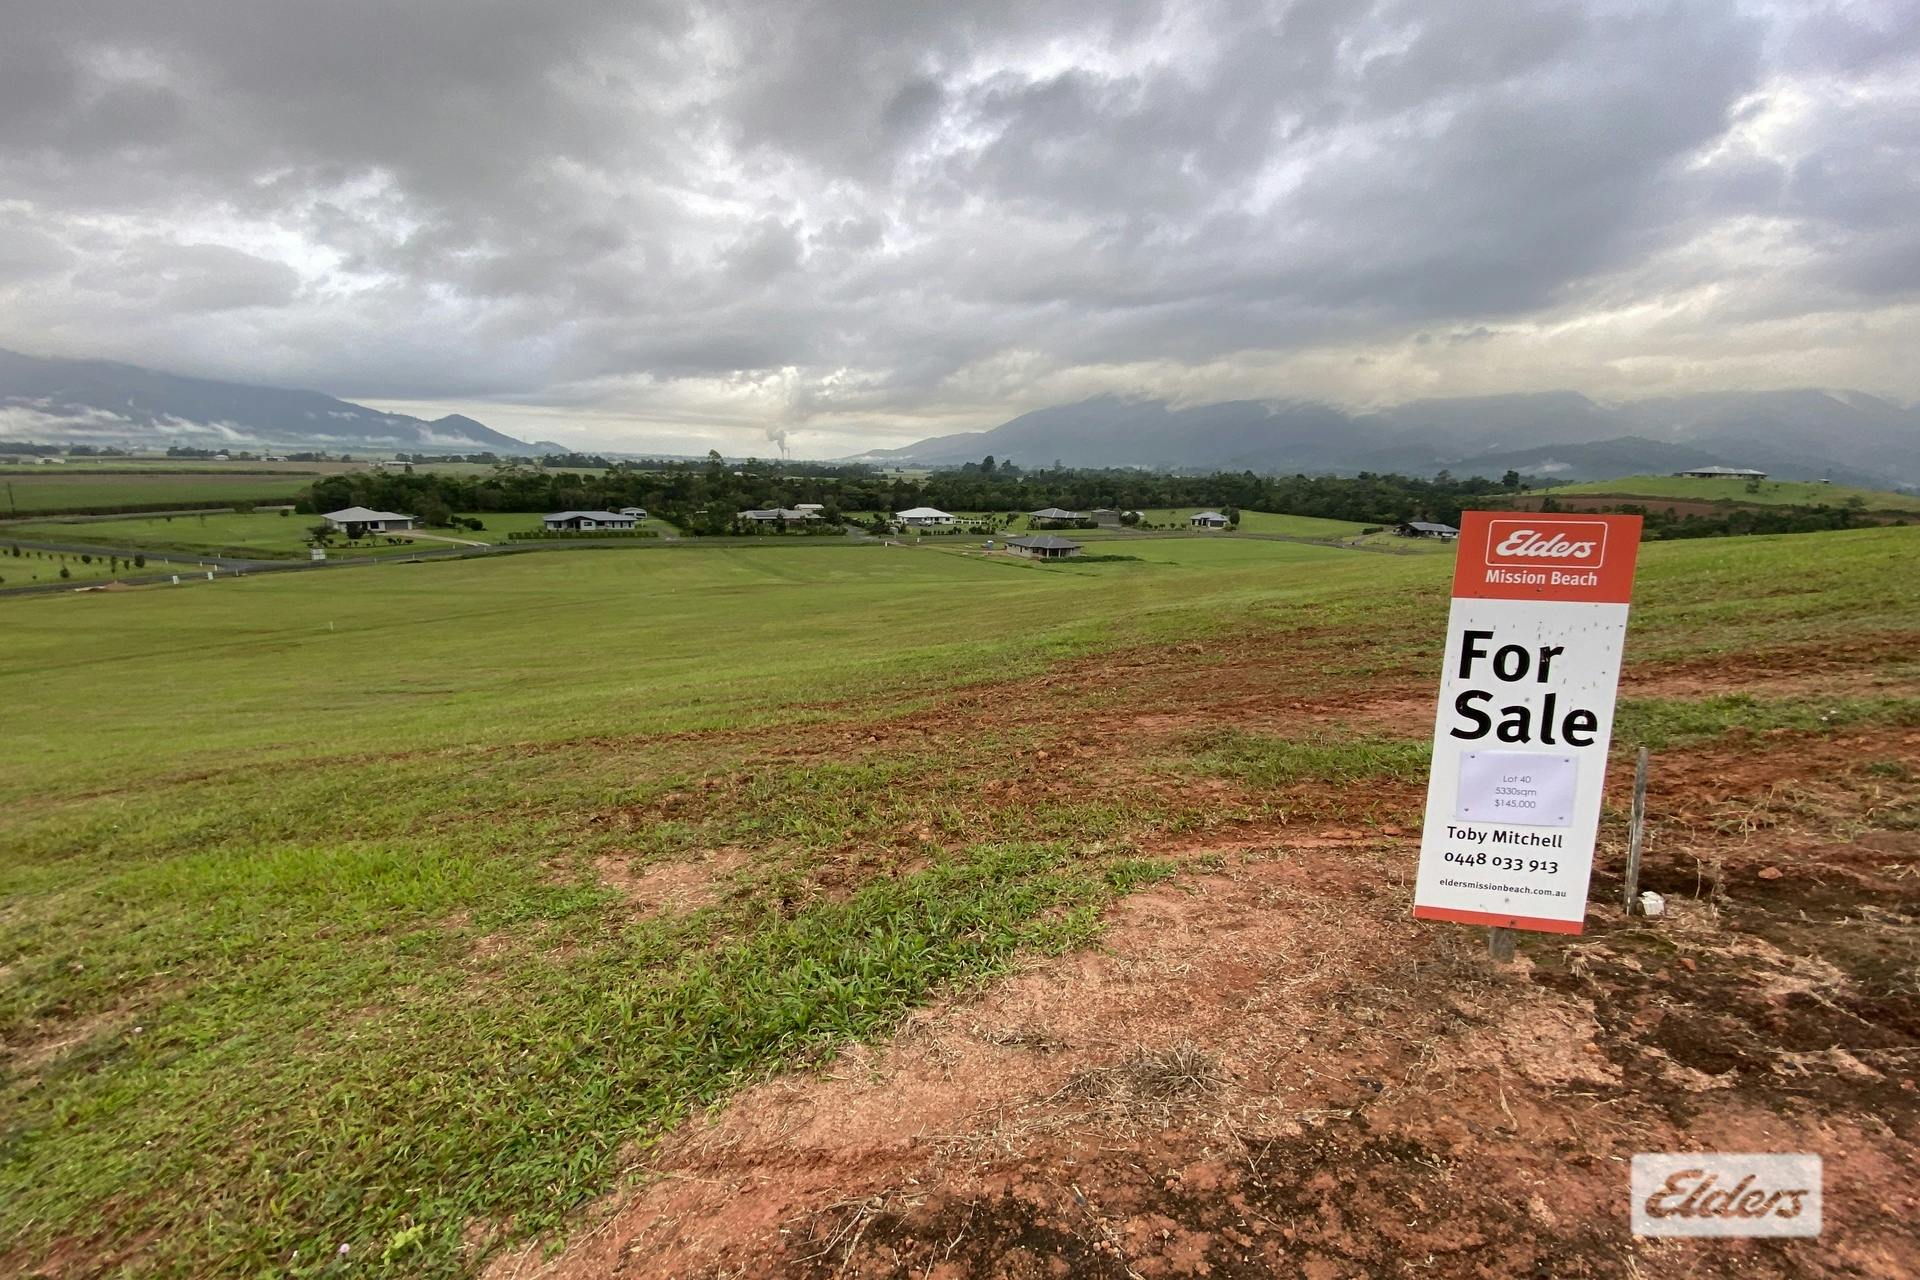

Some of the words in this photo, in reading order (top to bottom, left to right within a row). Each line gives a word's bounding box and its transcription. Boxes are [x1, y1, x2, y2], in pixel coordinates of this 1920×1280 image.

[1496, 530, 1597, 558] Elders
[1486, 569, 1546, 585] Mission
[1551, 571, 1598, 586] Beach
[1458, 630, 1565, 684] For
[1450, 689, 1598, 747] Sale
[1503, 775, 1518, 783] Lot
[1520, 776, 1531, 784] 40
[1447, 826, 1487, 844] Toby
[1492, 830, 1563, 848] Mitchell
[1444, 852, 1486, 866] 0448
[1492, 856, 1523, 871] 033
[1529, 860, 1558, 874] 913
[1439, 878, 1567, 898] eldersmissionbeach.com.au
